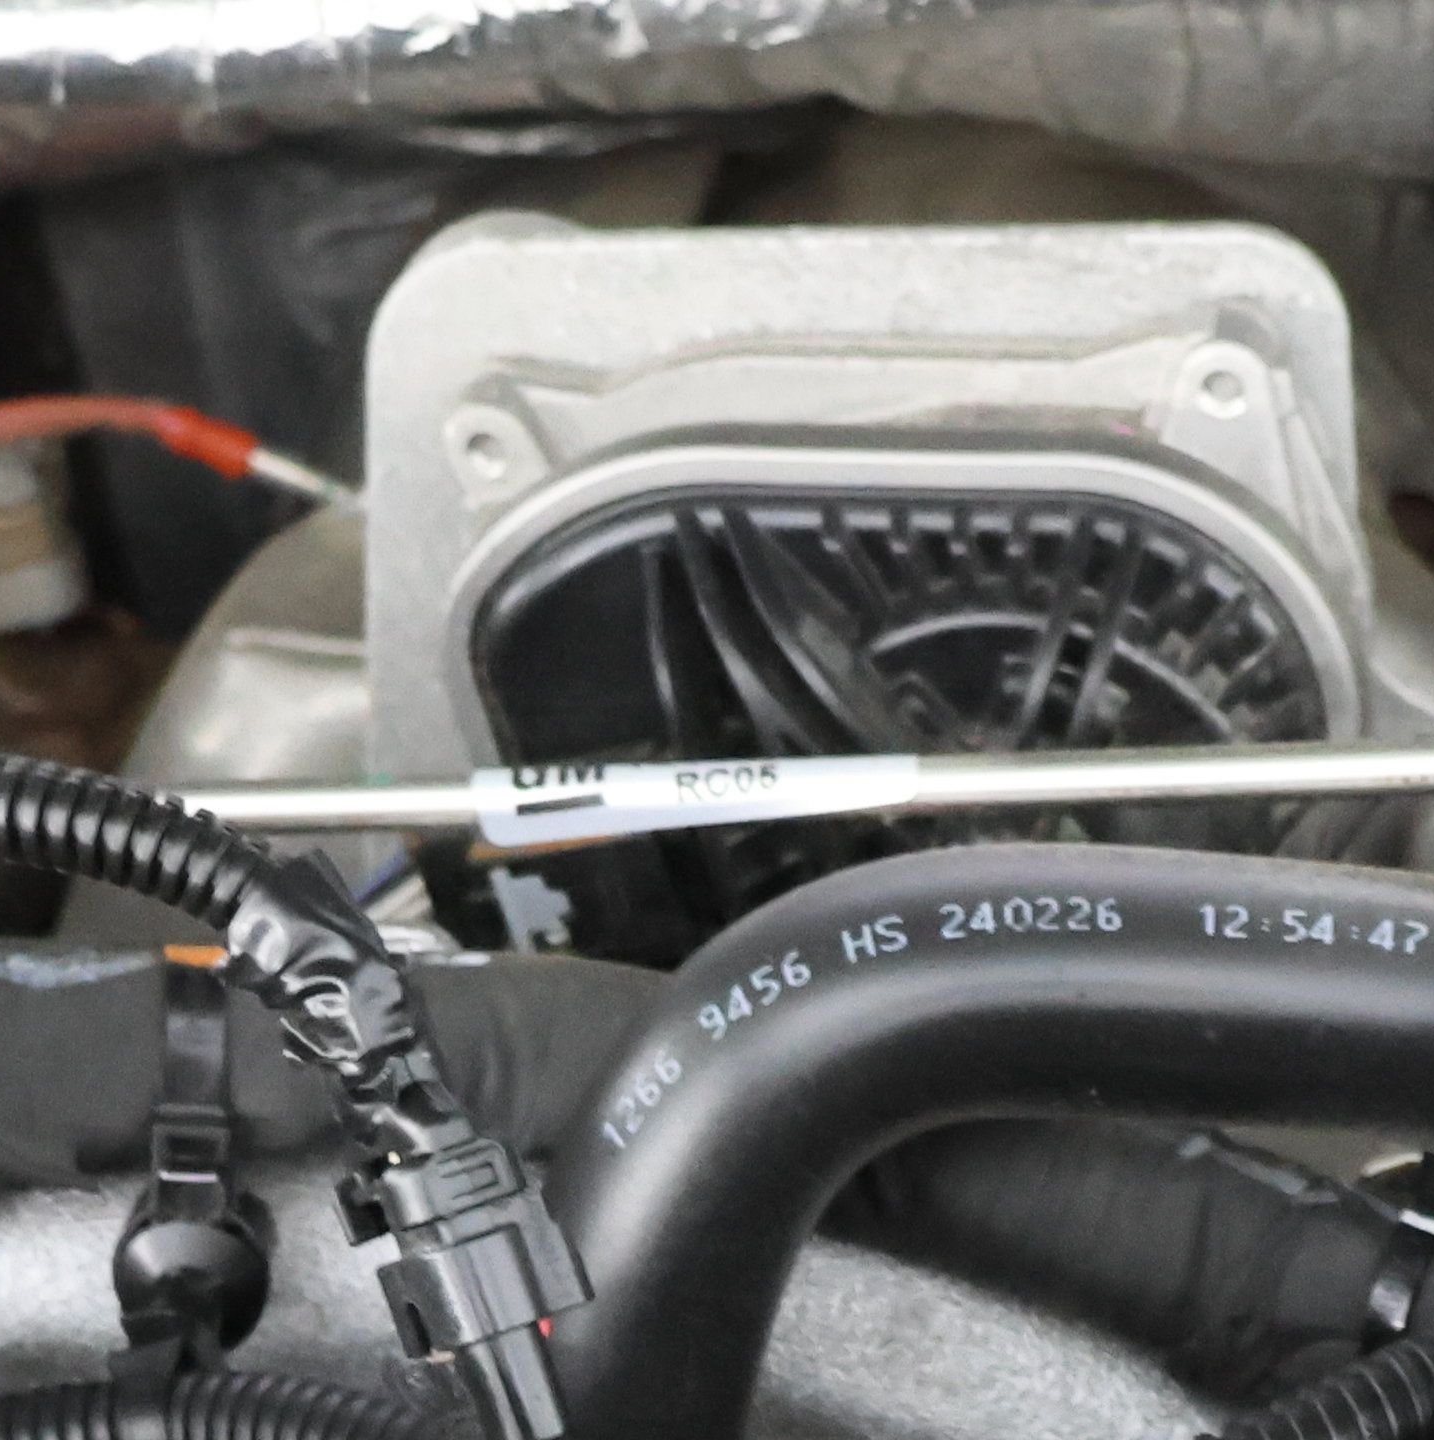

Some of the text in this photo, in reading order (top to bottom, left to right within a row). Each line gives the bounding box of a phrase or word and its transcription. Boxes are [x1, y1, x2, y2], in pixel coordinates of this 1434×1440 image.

[602, 1046, 682, 1149] 1266
[697, 950, 812, 1041] 9456
[840, 914, 908, 964] HS
[938, 896, 1123, 940] 240226
[1199, 903, 1430, 954] 12:54:47
